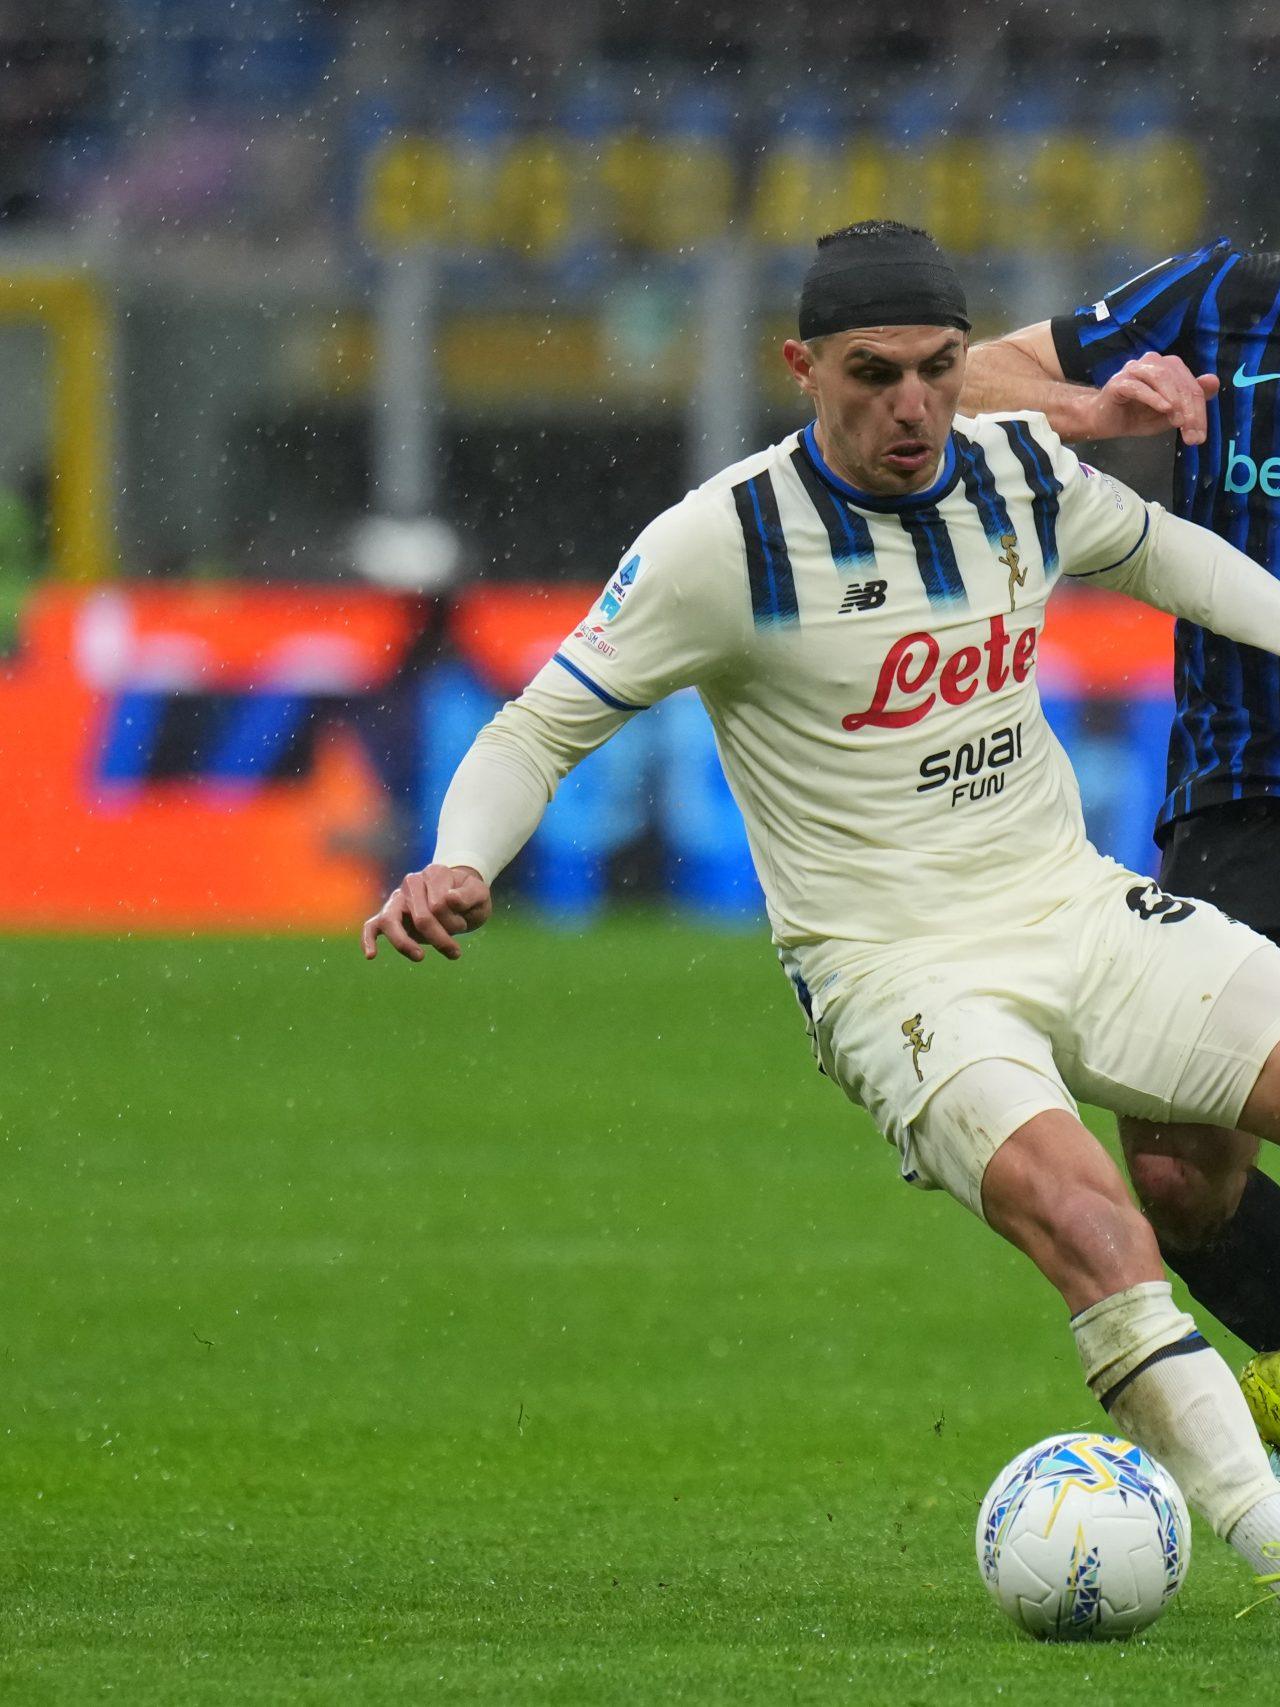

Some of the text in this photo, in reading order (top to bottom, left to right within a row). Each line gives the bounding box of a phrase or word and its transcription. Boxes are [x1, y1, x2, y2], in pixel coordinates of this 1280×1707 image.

[597, 640, 616, 657] OUT
[841, 614, 1036, 731] Lete
[952, 772, 1005, 807] FUN
